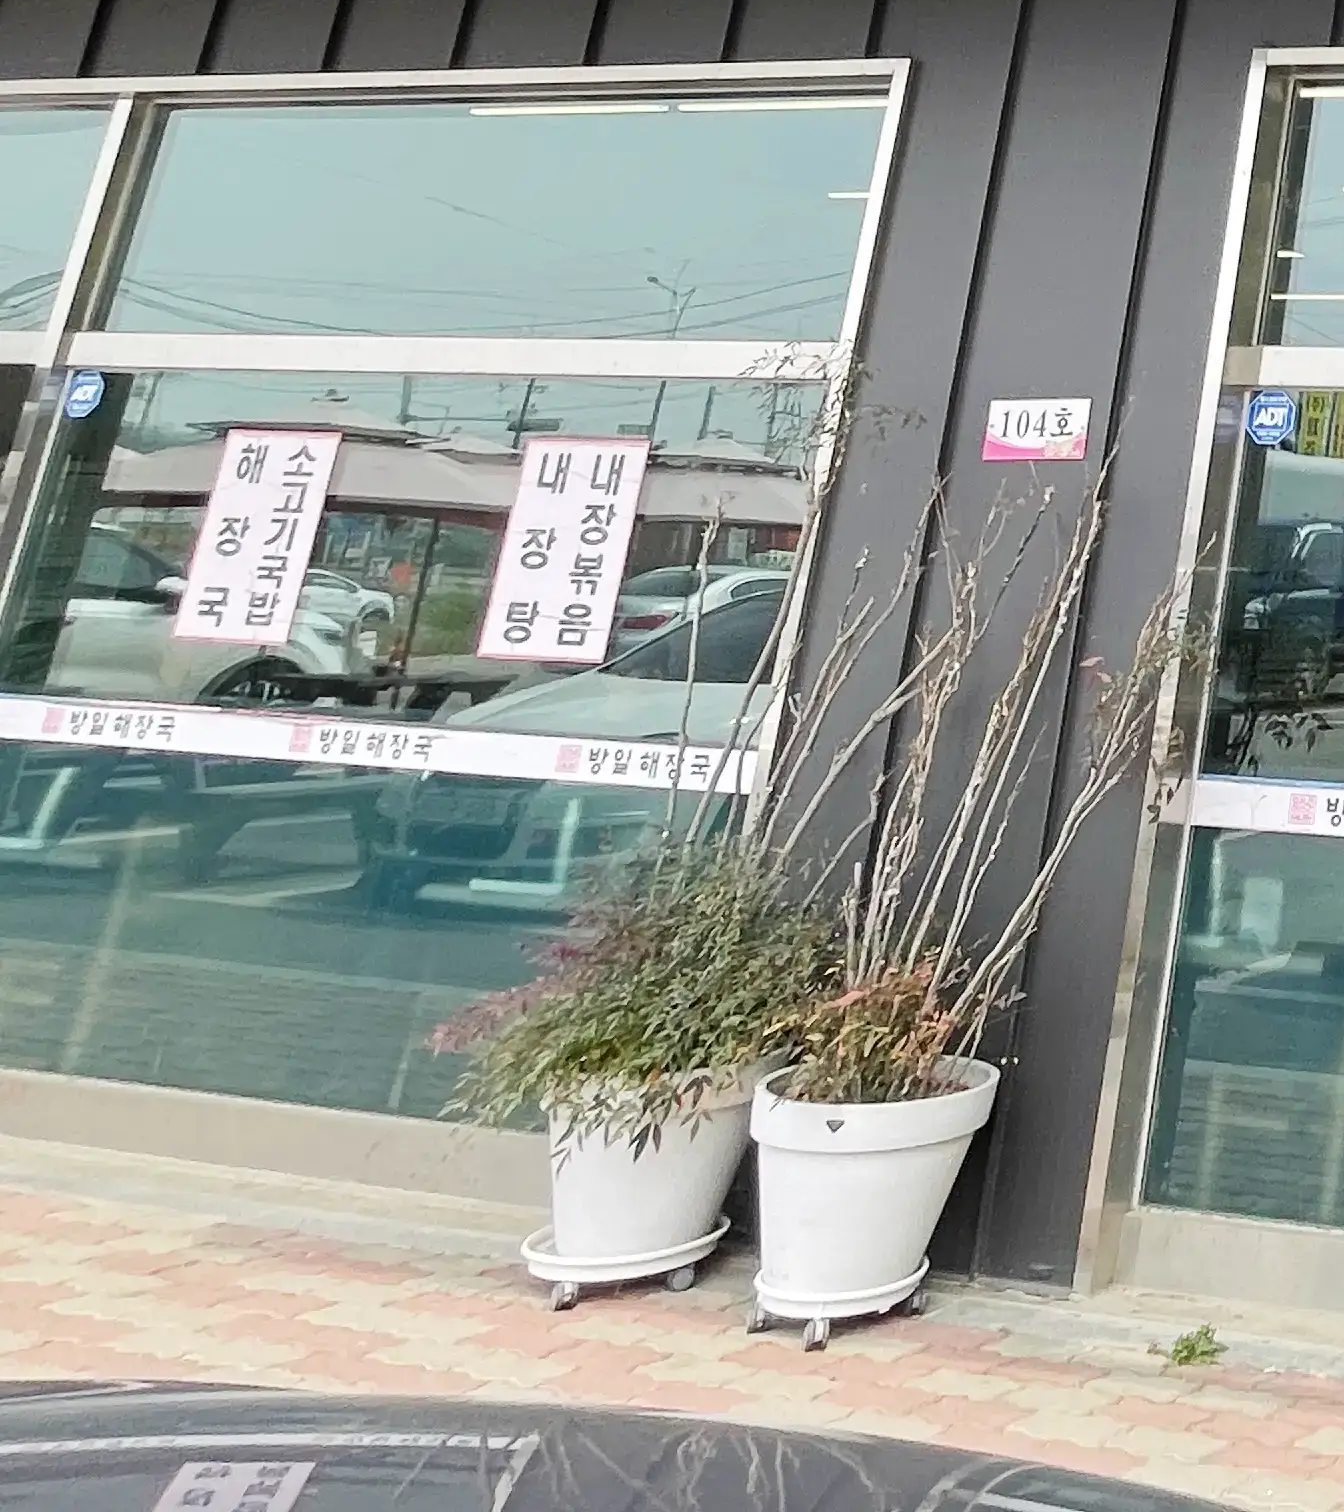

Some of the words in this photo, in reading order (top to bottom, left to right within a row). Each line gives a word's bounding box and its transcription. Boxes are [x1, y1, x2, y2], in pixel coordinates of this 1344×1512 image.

[1001, 407, 1073, 440] 104호
[1253, 407, 1284, 427] ADT
[198, 443, 269, 627] 해장국
[245, 445, 317, 626] 소고기국밥
[503, 452, 573, 644] 내장탕
[557, 454, 626, 646] 내장볶음
[69, 709, 177, 742] 방일해장국
[319, 729, 435, 763] 방일해장국
[588, 747, 711, 783] 방일해장국
